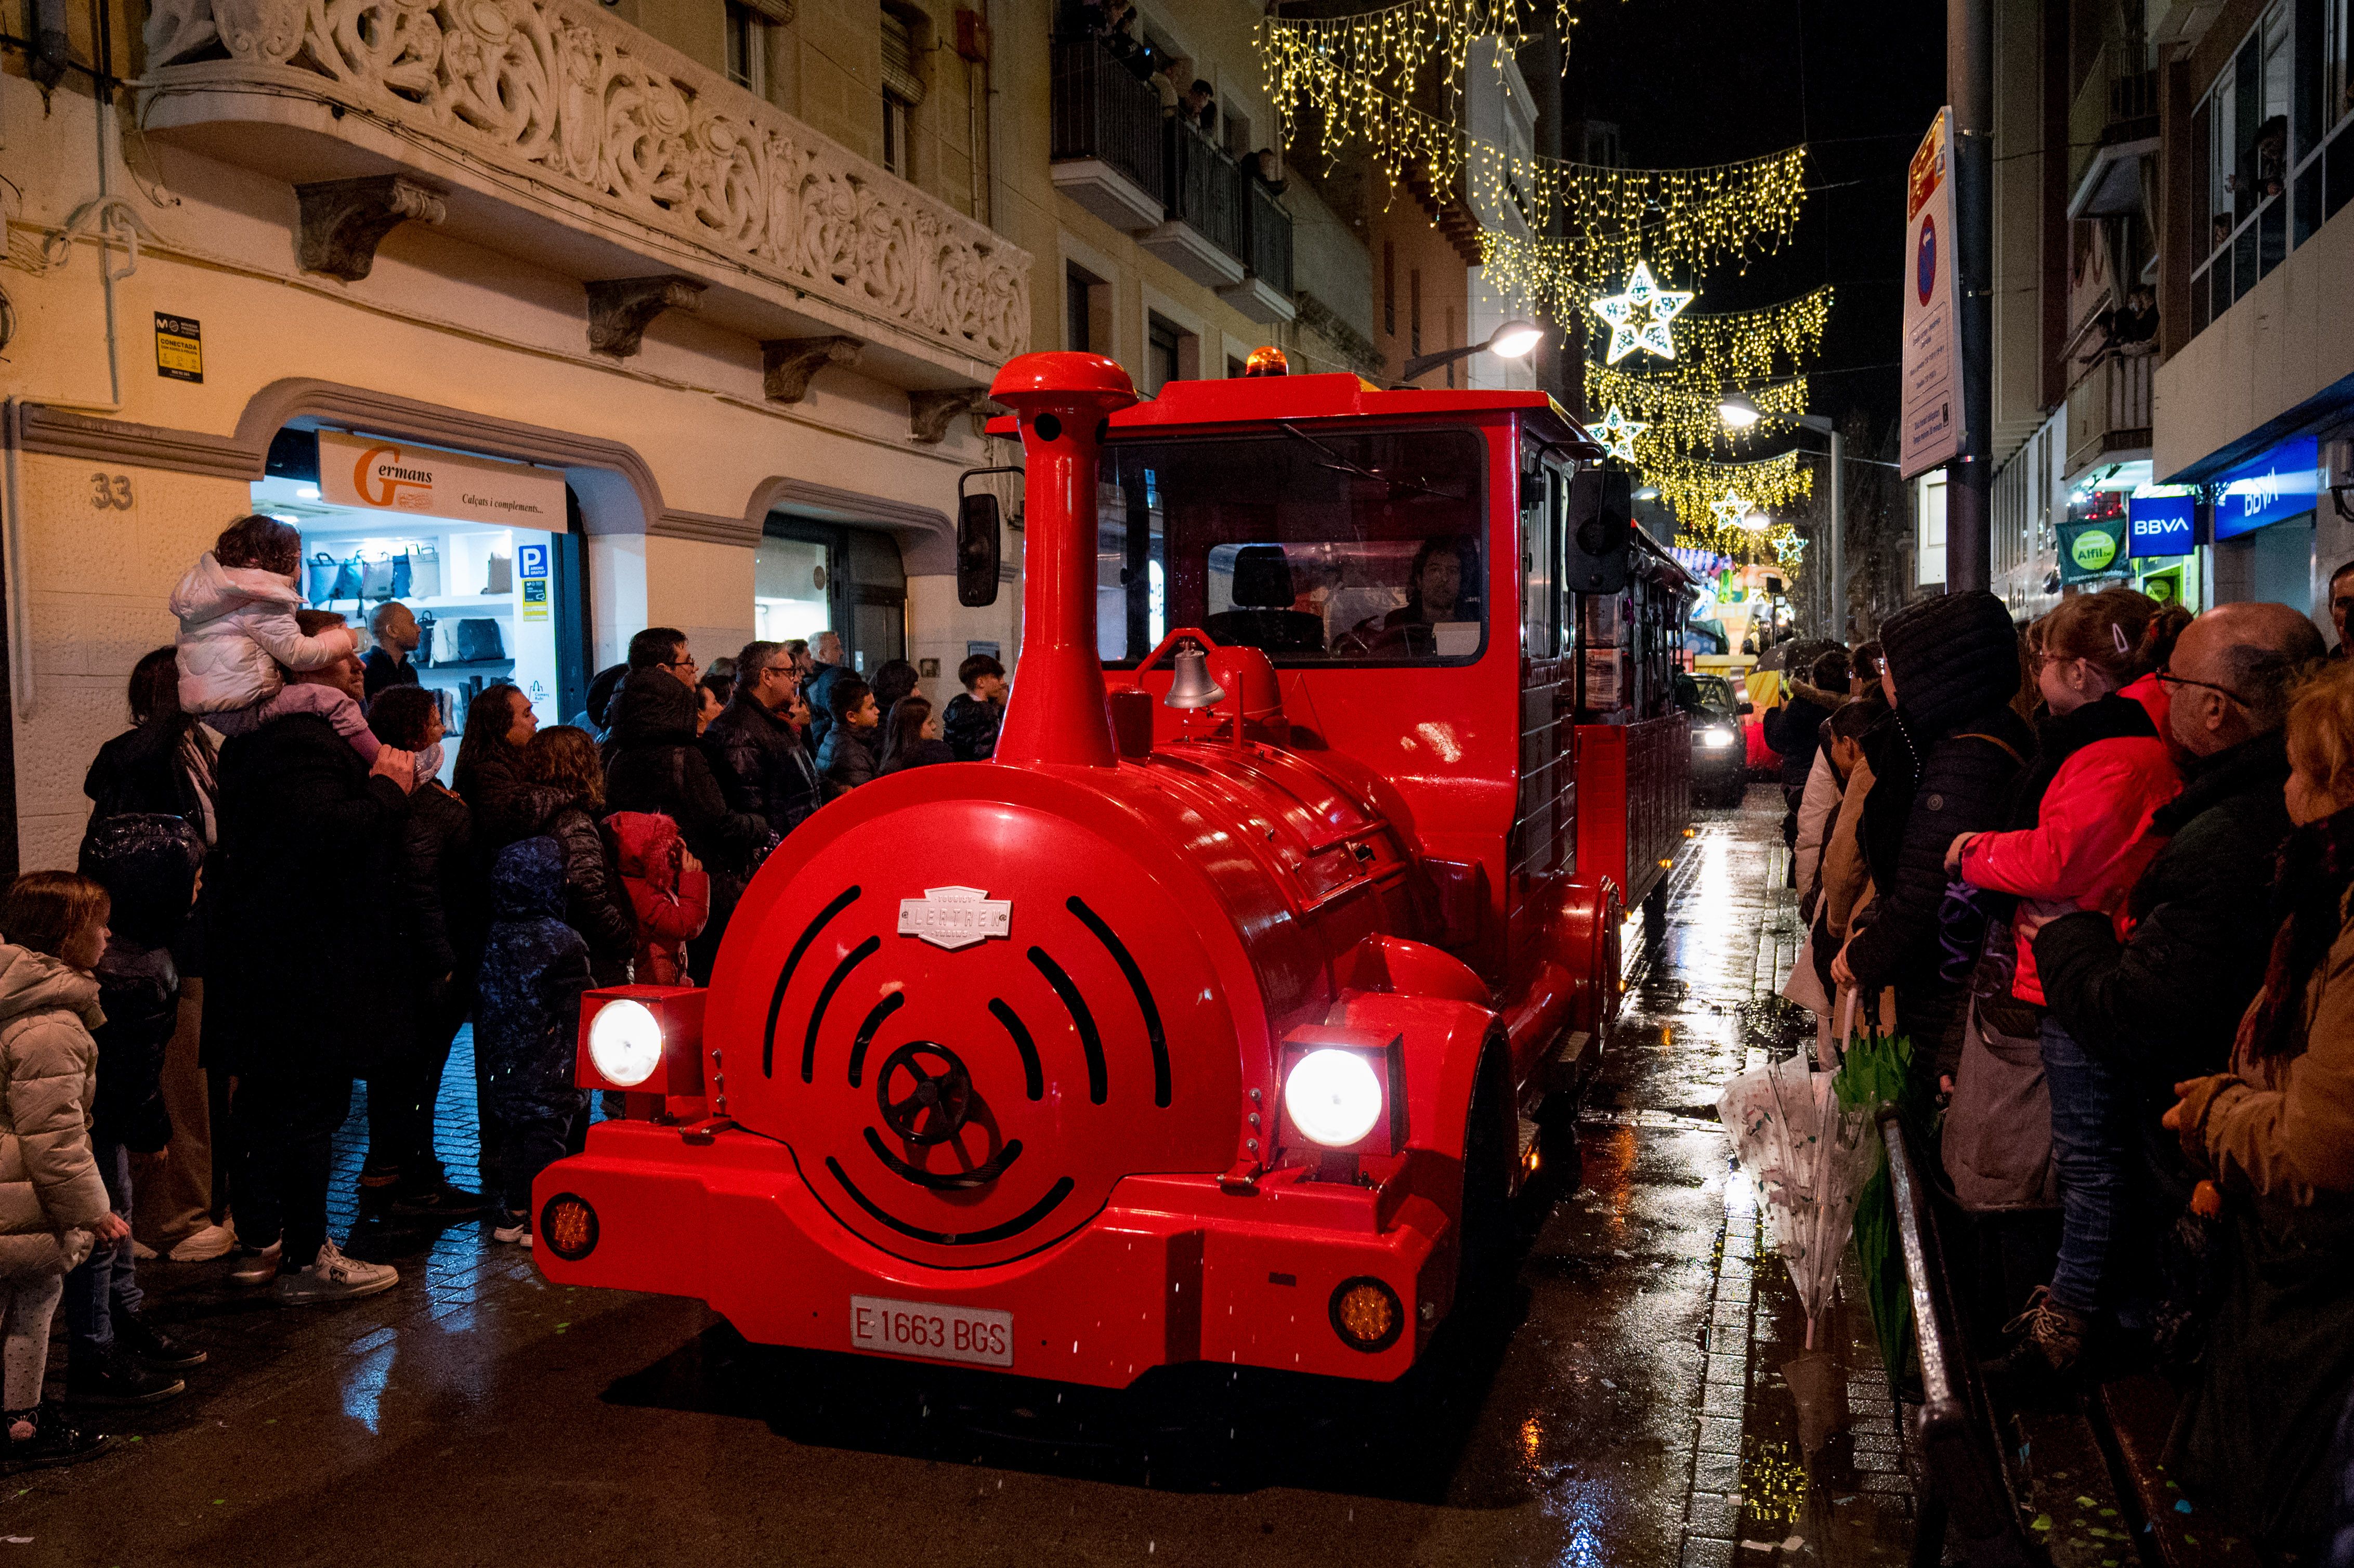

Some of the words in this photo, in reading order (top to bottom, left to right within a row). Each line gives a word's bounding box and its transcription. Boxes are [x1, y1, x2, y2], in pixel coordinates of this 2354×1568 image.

[160, 338, 197, 350] CONECTADA
[354, 446, 433, 506] Germans
[90, 473, 133, 510] 33
[462, 493, 488, 507] Calçats
[490, 497, 493, 507] i
[2244, 467, 2279, 517] BBVA
[2134, 517, 2189, 535] BBVA
[938, 895, 973, 903] TOURIST
[856, 1307, 873, 1339] E
[882, 1309, 945, 1348] 1663
[954, 1319, 1005, 1355] BGS
